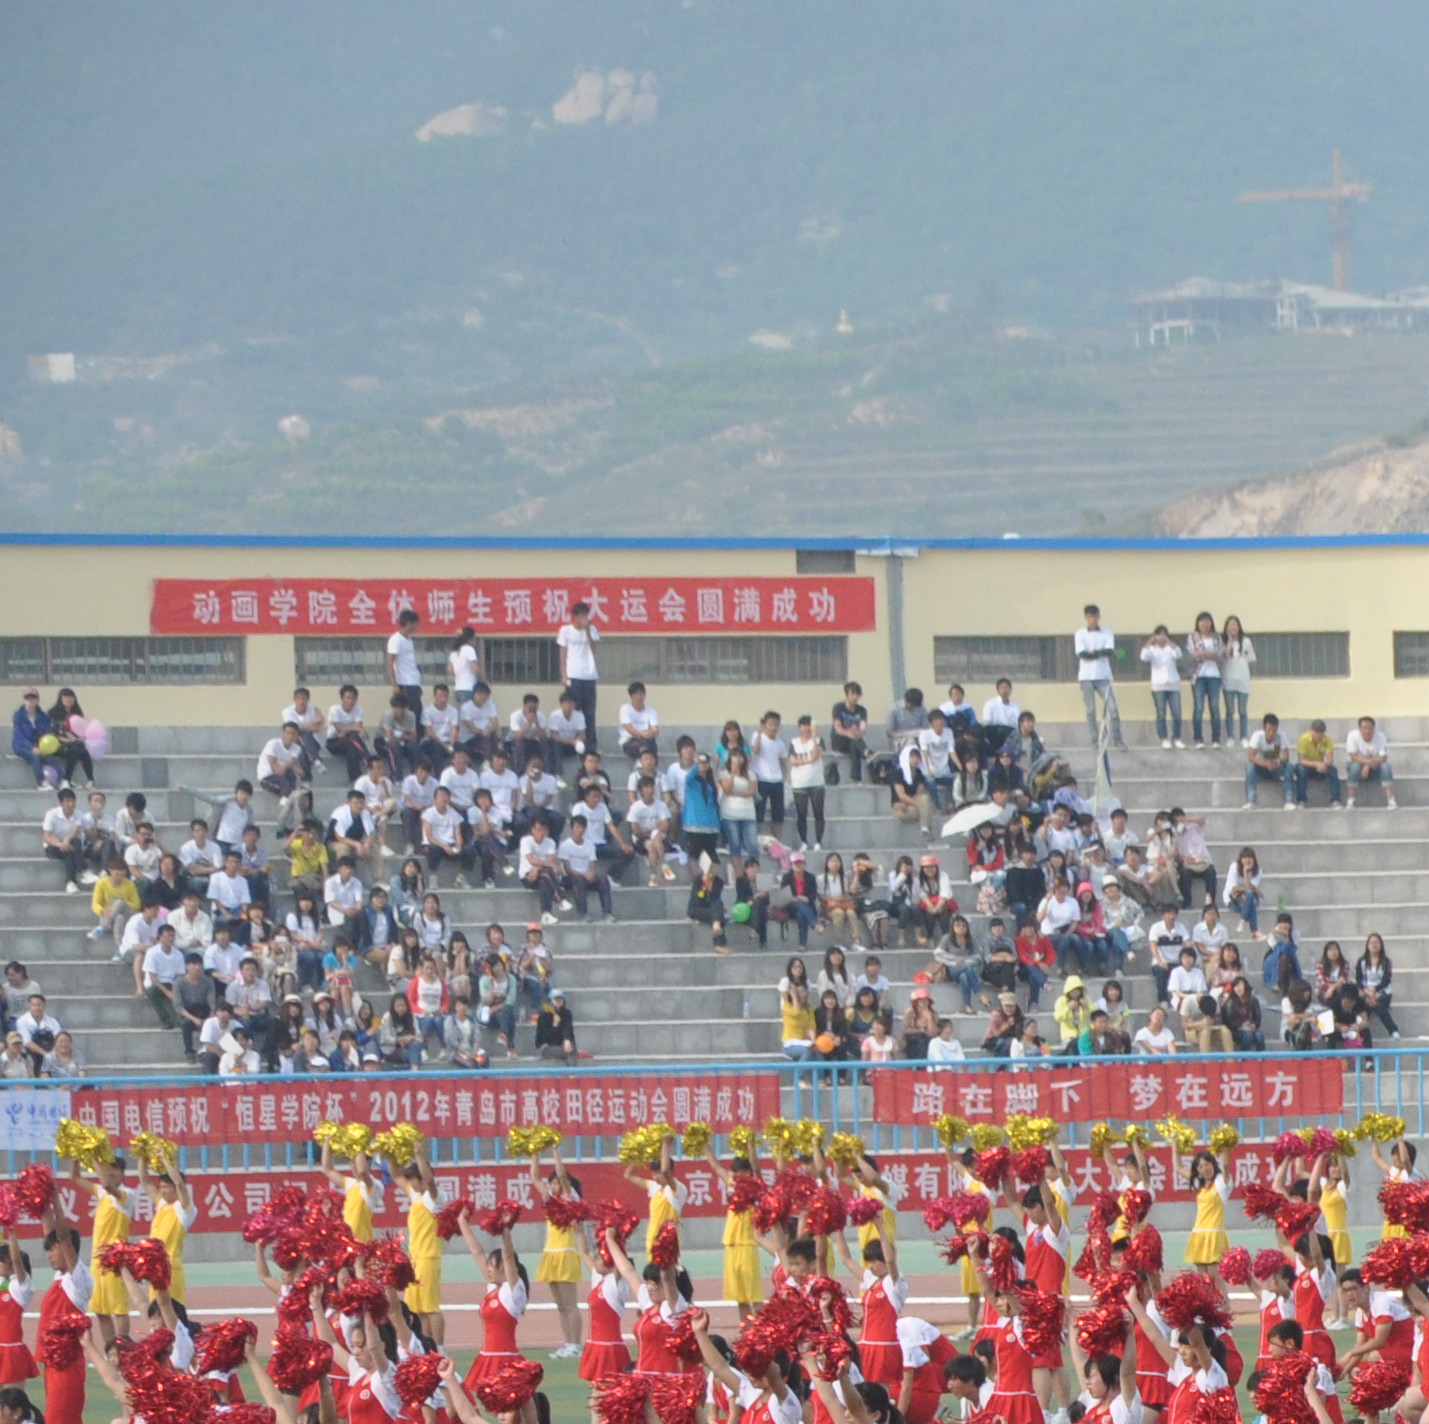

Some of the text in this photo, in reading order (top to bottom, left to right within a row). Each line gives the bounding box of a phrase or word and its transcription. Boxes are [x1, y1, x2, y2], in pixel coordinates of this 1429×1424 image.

[192, 586, 837, 625] 动画学院全体师生预祝大运会圆满成功
[912, 1070, 1299, 1115] 路在脚下 梦在远方
